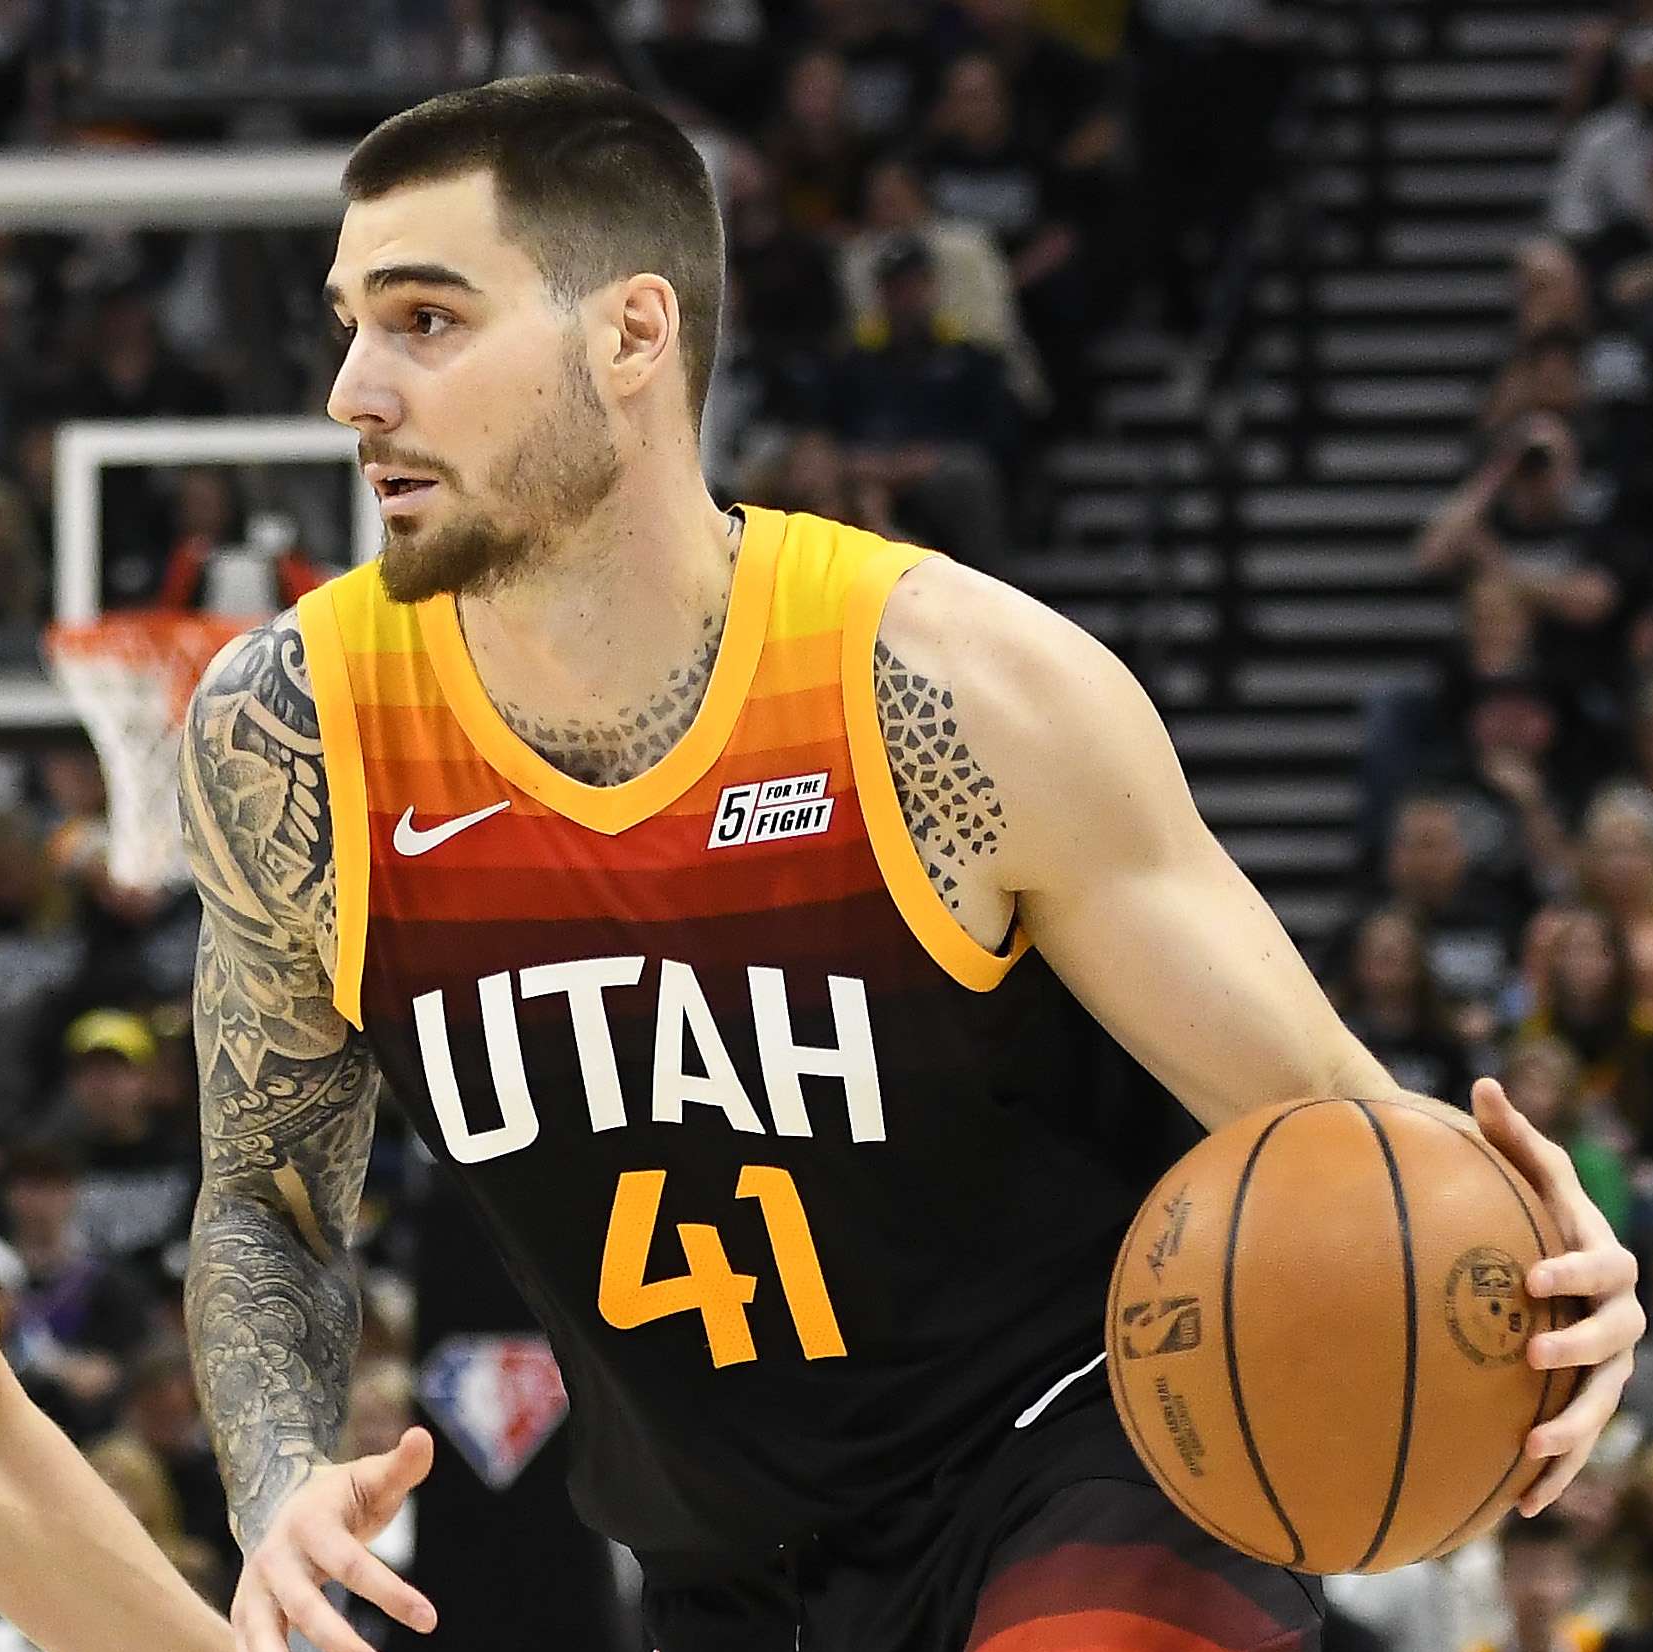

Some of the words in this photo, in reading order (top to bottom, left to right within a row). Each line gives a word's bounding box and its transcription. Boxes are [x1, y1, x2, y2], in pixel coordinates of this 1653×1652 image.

[765, 784, 792, 800] FOR
[796, 779, 821, 796] THE
[718, 790, 751, 841] 5
[755, 804, 828, 837] FIGHT
[411, 955, 888, 1165] UTAH
[597, 1164, 849, 1369] 41
